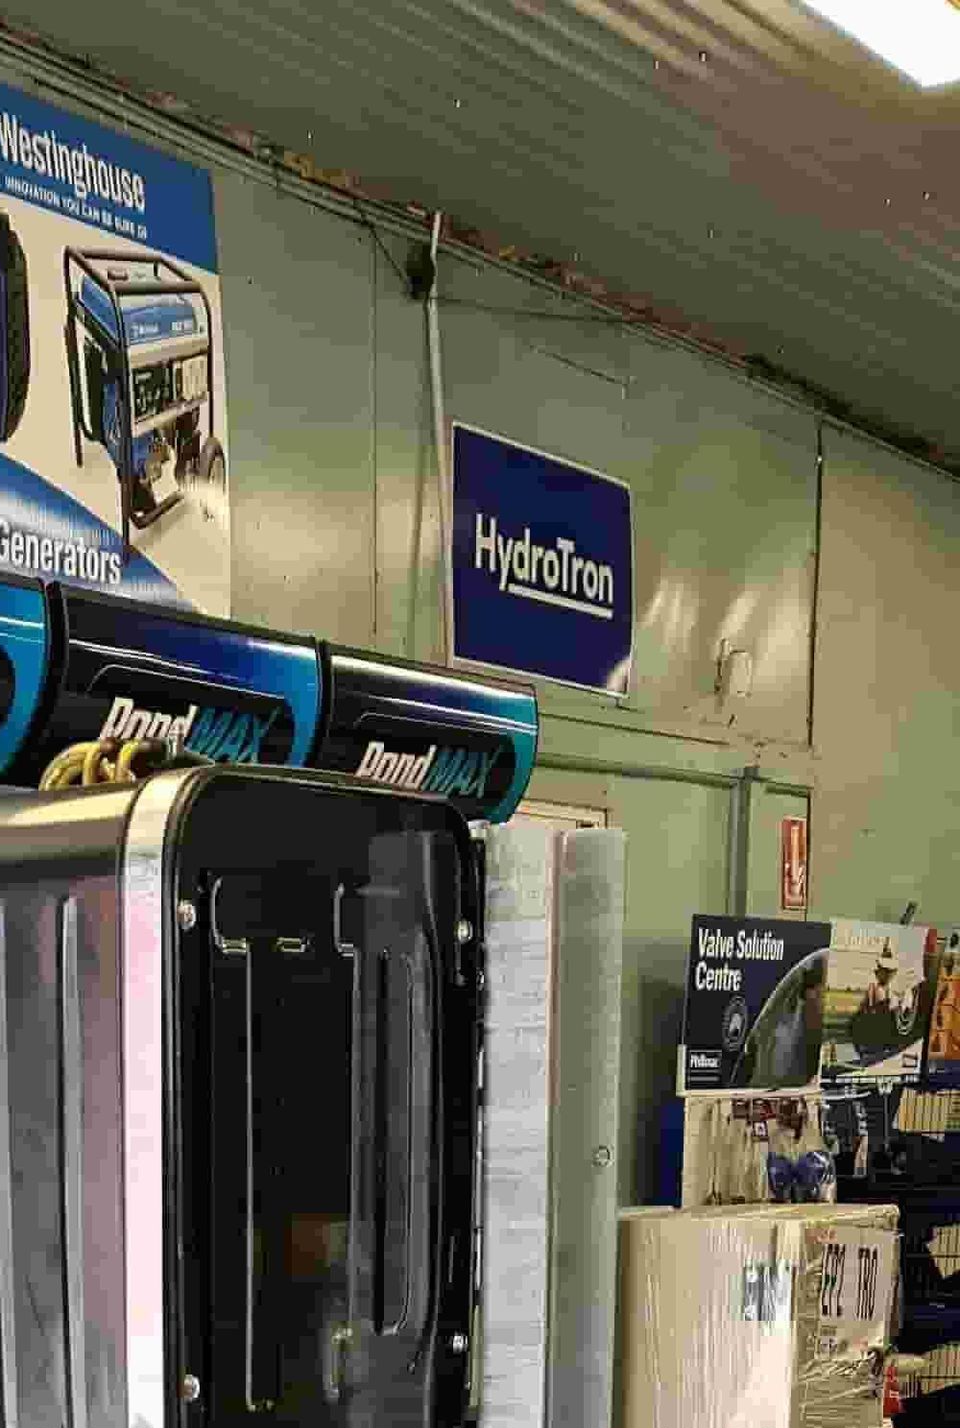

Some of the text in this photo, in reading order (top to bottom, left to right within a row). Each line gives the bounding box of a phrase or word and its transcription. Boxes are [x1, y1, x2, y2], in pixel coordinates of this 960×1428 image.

[475, 512, 613, 604] HydroTron
[354, 741, 504, 799] PondMAX
[698, 928, 784, 961] Valve Solution
[695, 961, 742, 992] Centre
